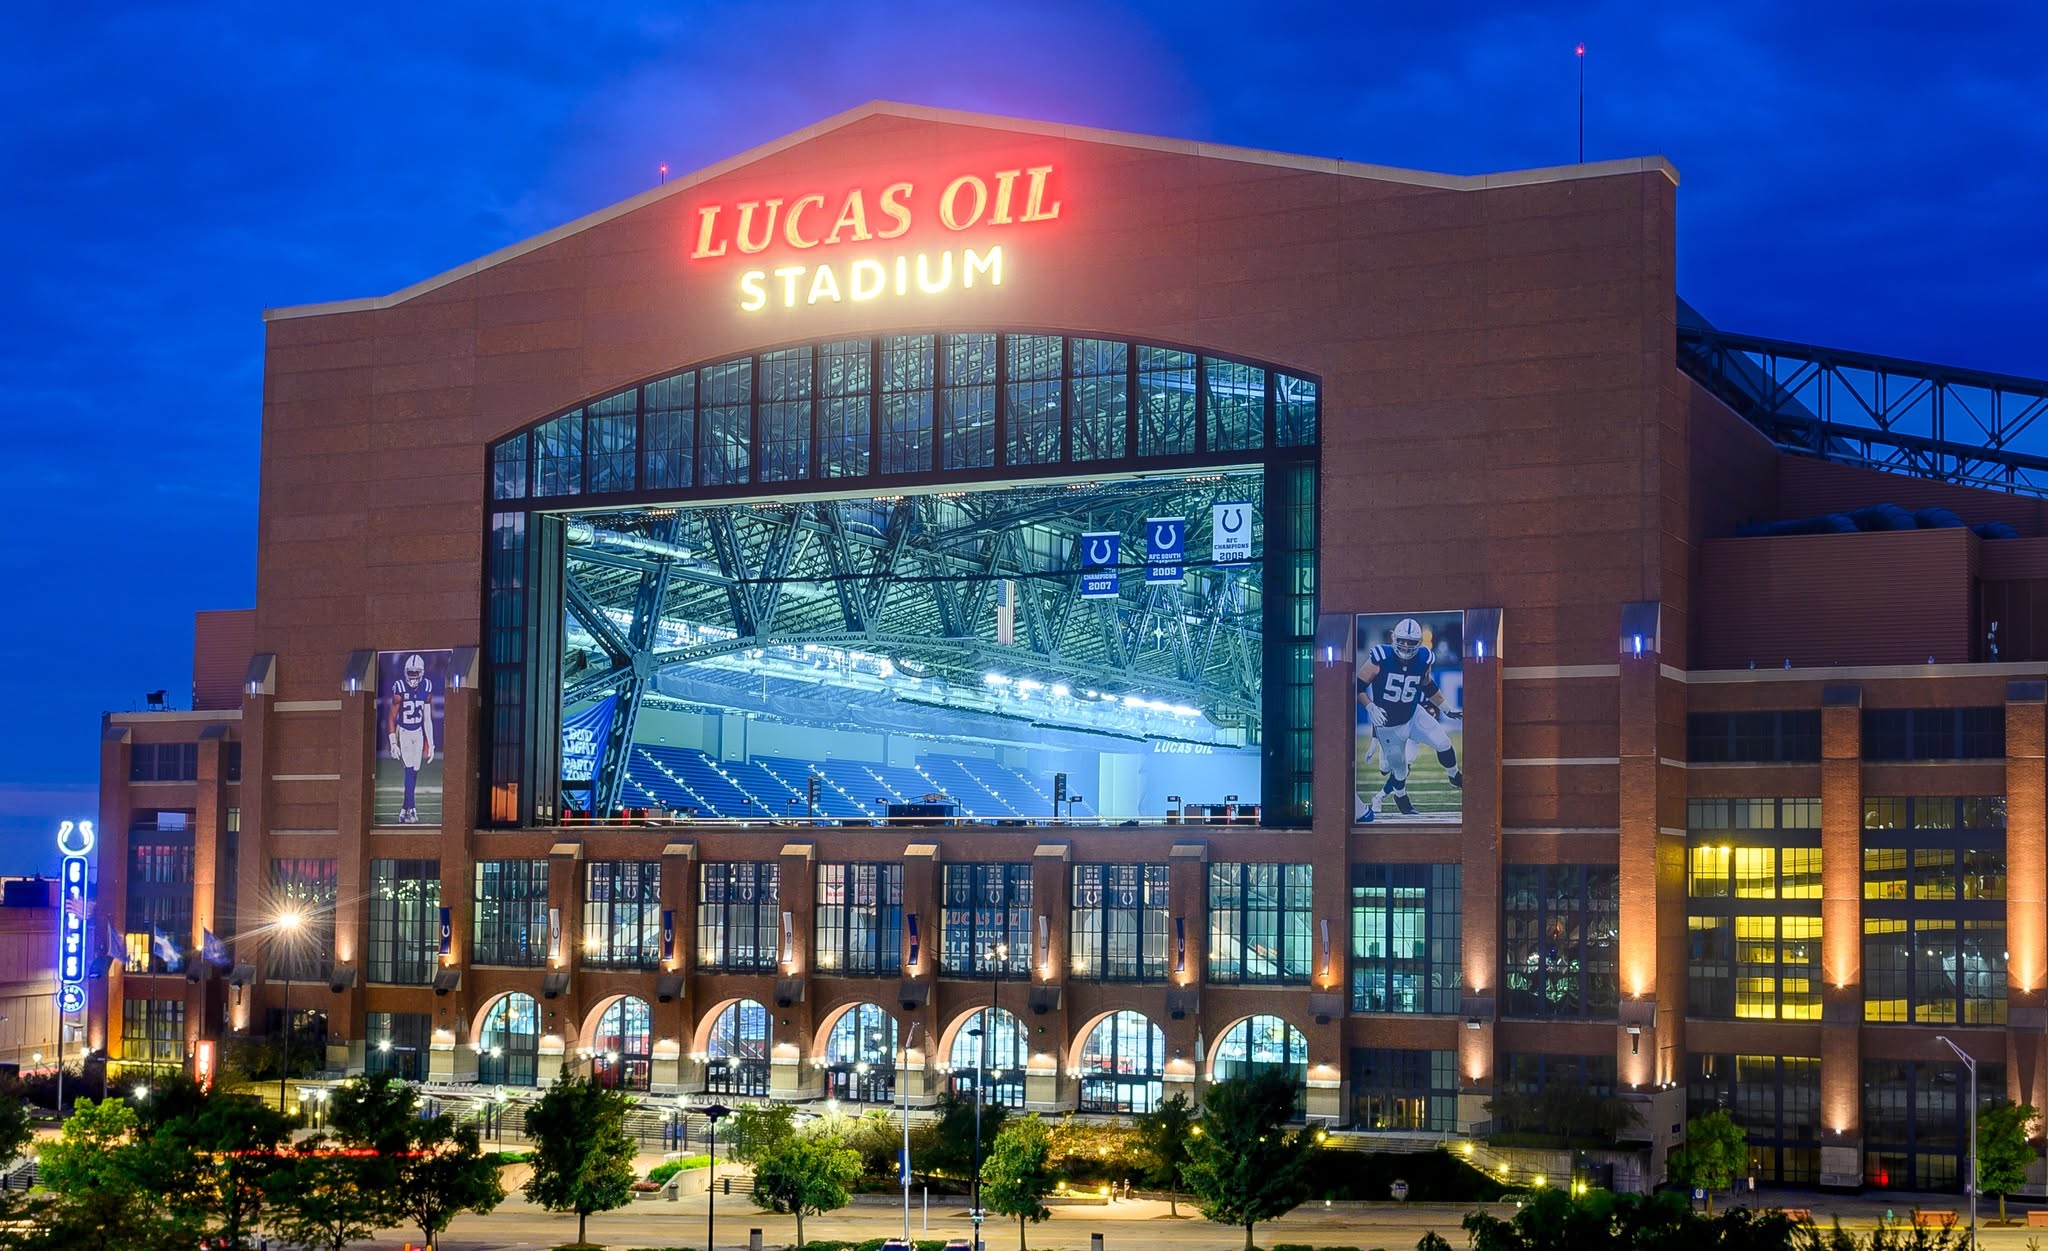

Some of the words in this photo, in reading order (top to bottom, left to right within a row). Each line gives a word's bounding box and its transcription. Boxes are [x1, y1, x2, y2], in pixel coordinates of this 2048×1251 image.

[691, 182, 914, 260] LUCAS
[938, 164, 1062, 232] OIL
[740, 245, 1003, 312] STADIUM
[1161, 552, 1181, 560] SOUTH
[1219, 551, 1244, 561] 2009
[1152, 567, 1177, 576] 2009
[1088, 581, 1112, 590] 2007
[1383, 672, 1420, 703] 56
[403, 700, 424, 724] 23
[568, 728, 593, 742] BUD
[563, 740, 597, 755] LIGHT
[1154, 742, 1192, 754] LUCAS
[1194, 744, 1213, 754] OIL
[563, 757, 595, 771] PARTY
[566, 770, 592, 781] ZONE
[955, 929, 1004, 938] STDIUM
[691, 1095, 729, 1105] LUCAS
